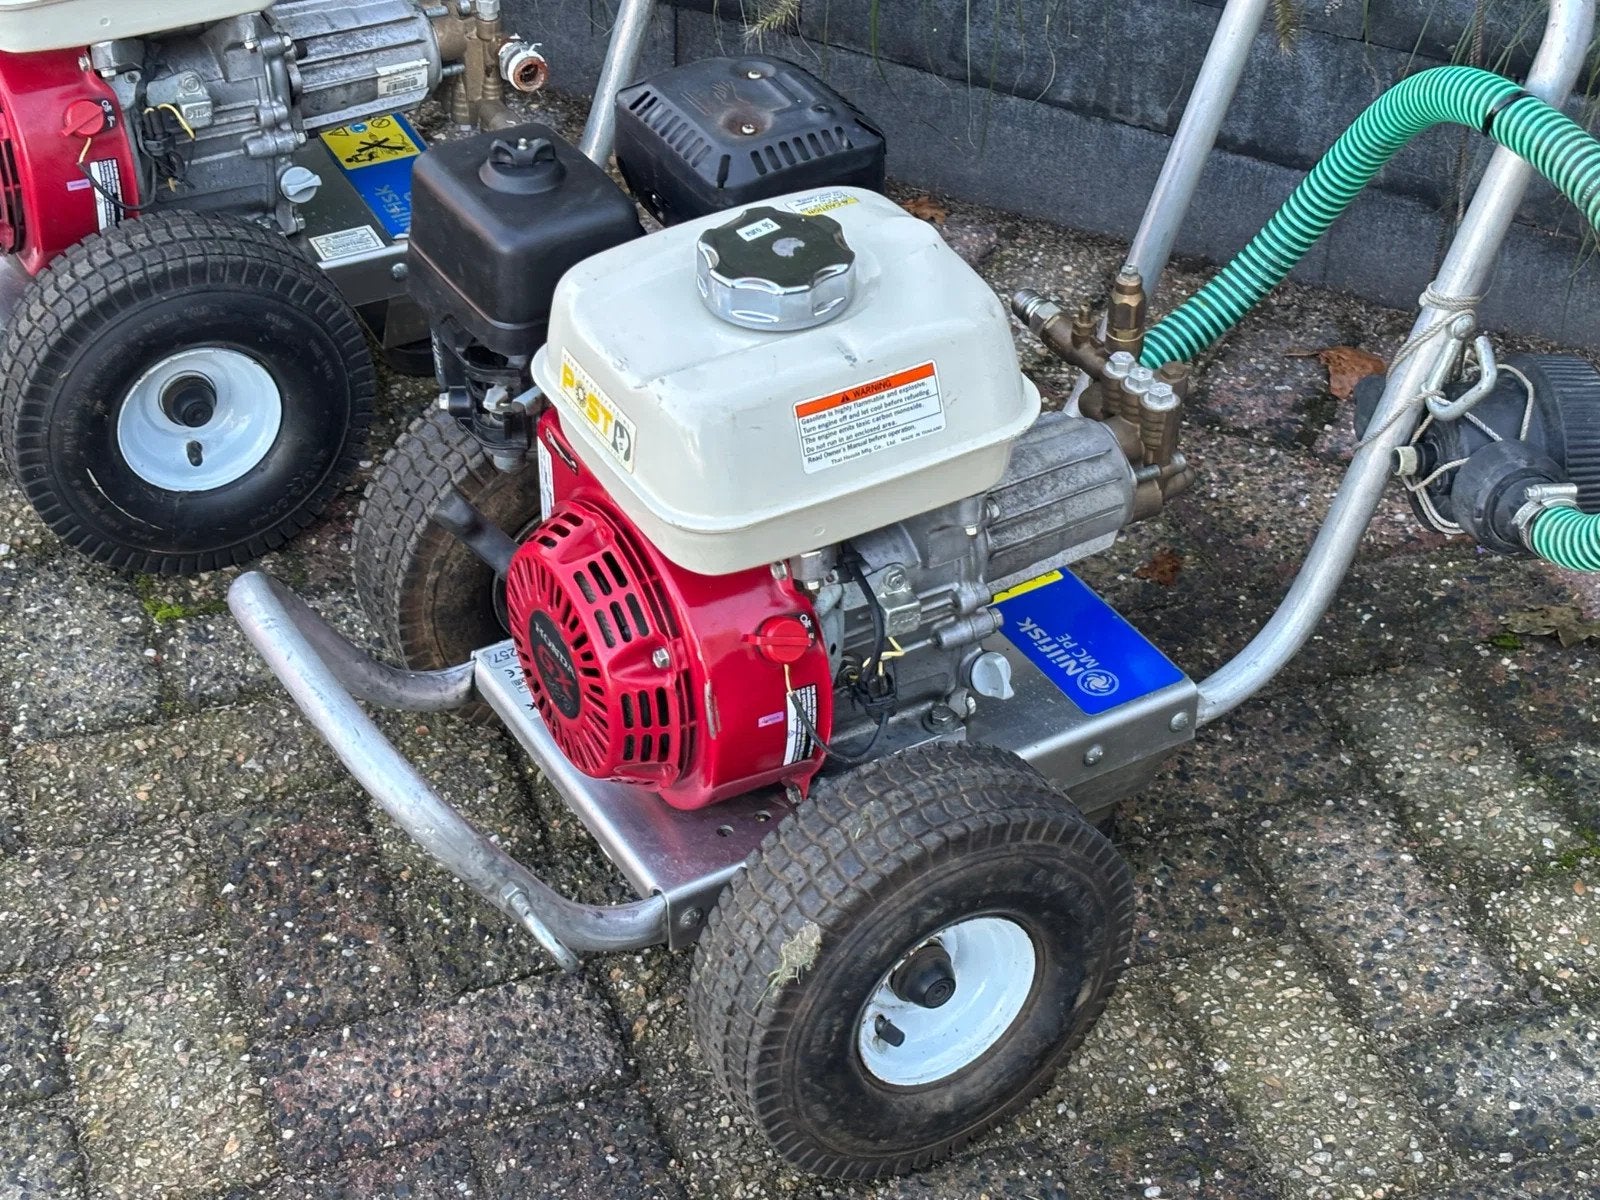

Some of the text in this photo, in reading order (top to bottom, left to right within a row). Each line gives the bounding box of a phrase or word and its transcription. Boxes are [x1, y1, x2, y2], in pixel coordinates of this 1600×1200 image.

[852, 379, 892, 398] WARNING
[801, 412, 827, 425] Gasoline
[834, 405, 852, 416] highly
[853, 393, 885, 409] flammable
[887, 389, 898, 399] and
[803, 426, 817, 434] Turn
[818, 419, 838, 430] engine
[839, 414, 848, 423] off
[849, 409, 860, 420] and
[861, 408, 869, 416] let
[870, 403, 883, 413] cool
[884, 397, 904, 408] before
[804, 436, 816, 445] The
[817, 430, 838, 441] engine
[839, 424, 855, 434] emits
[856, 418, 871, 428] toxic
[872, 412, 893, 423] carbon
[805, 446, 815, 454] Do
[816, 442, 826, 451] not
[827, 439, 838, 447] run
[854, 424, 881, 438] enclosed
[807, 453, 823, 464] Read
[823, 446, 847, 459] Owner's
[847, 438, 868, 451] Manual
[868, 433, 888, 444] before
[831, 456, 843, 465] Thai
[534, 620, 577, 679] HONDA
[1016, 616, 1084, 677] Nilfisk
[1055, 632, 1100, 669] MC PE
